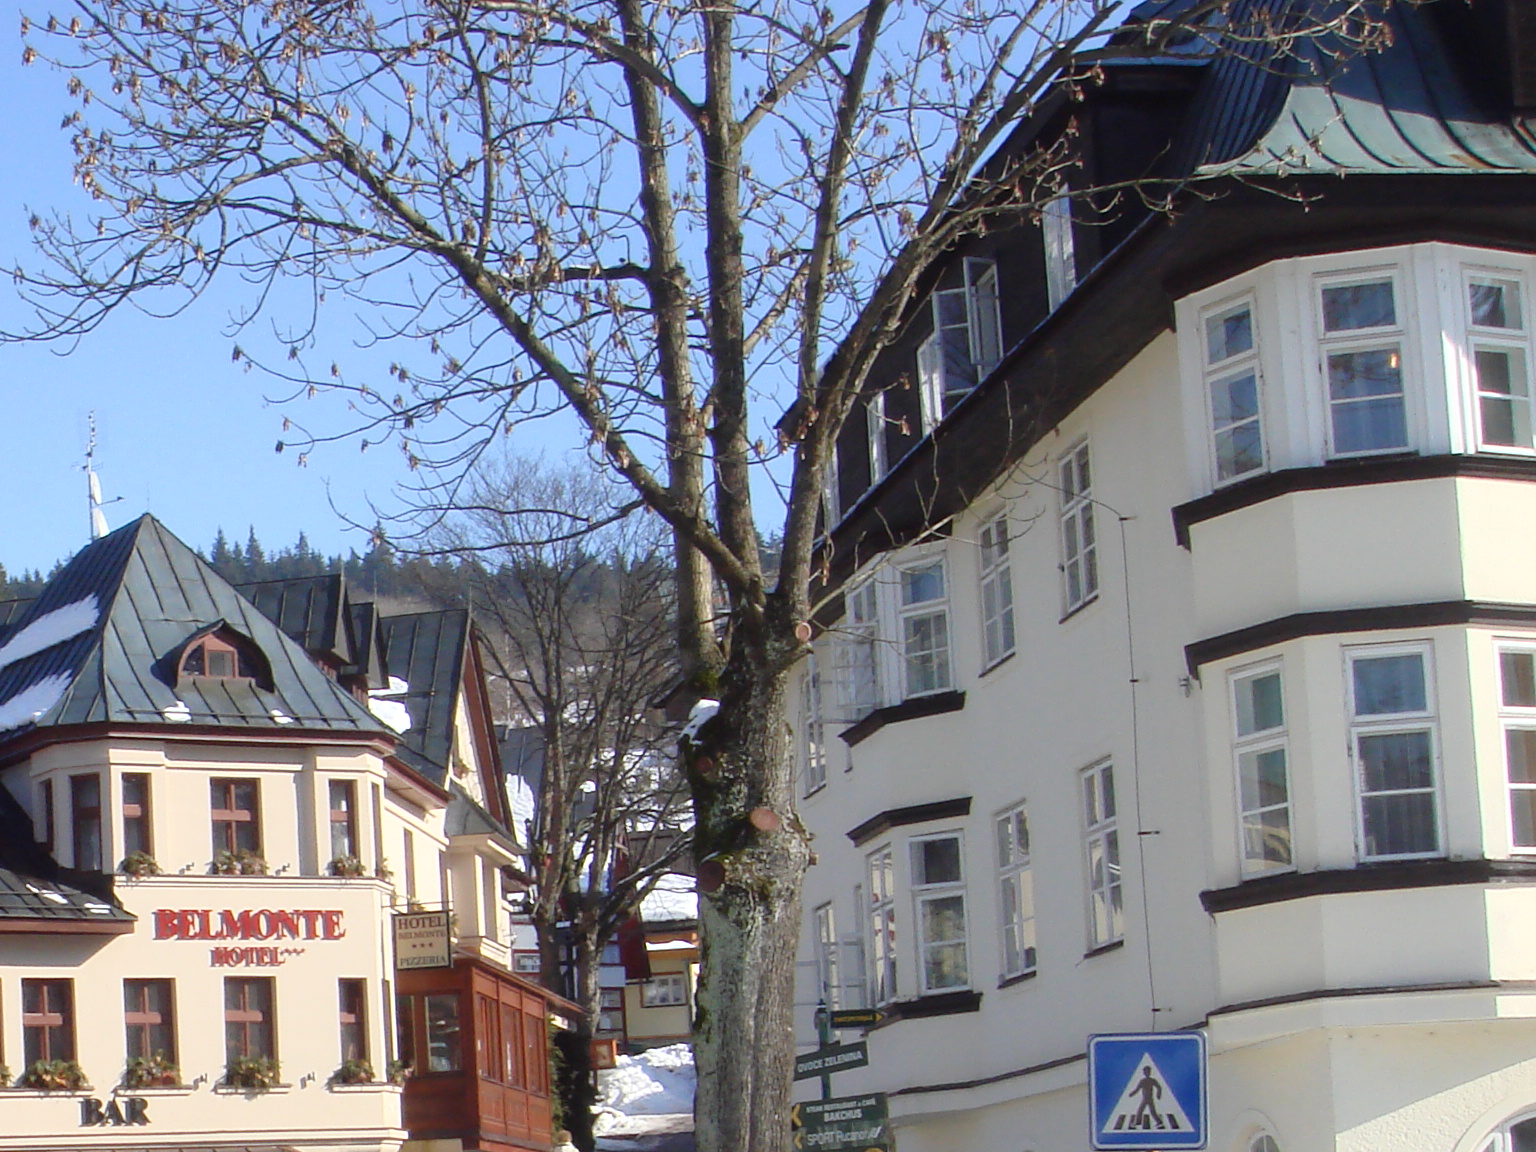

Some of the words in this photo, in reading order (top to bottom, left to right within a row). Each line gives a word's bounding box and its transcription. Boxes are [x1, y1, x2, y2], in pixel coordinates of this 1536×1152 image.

[154, 909, 346, 941] BELMONTE
[398, 916, 446, 930] HOTEL
[398, 930, 446, 940] BELMONTE
[210, 946, 285, 968] HOTEL
[400, 955, 447, 967] PIZZERIA
[797, 1059, 824, 1073] OVOCE
[78, 1098, 152, 1127] BAR
[824, 1108, 862, 1122] BAKCHUS
[806, 1131, 835, 1146] SPORT
